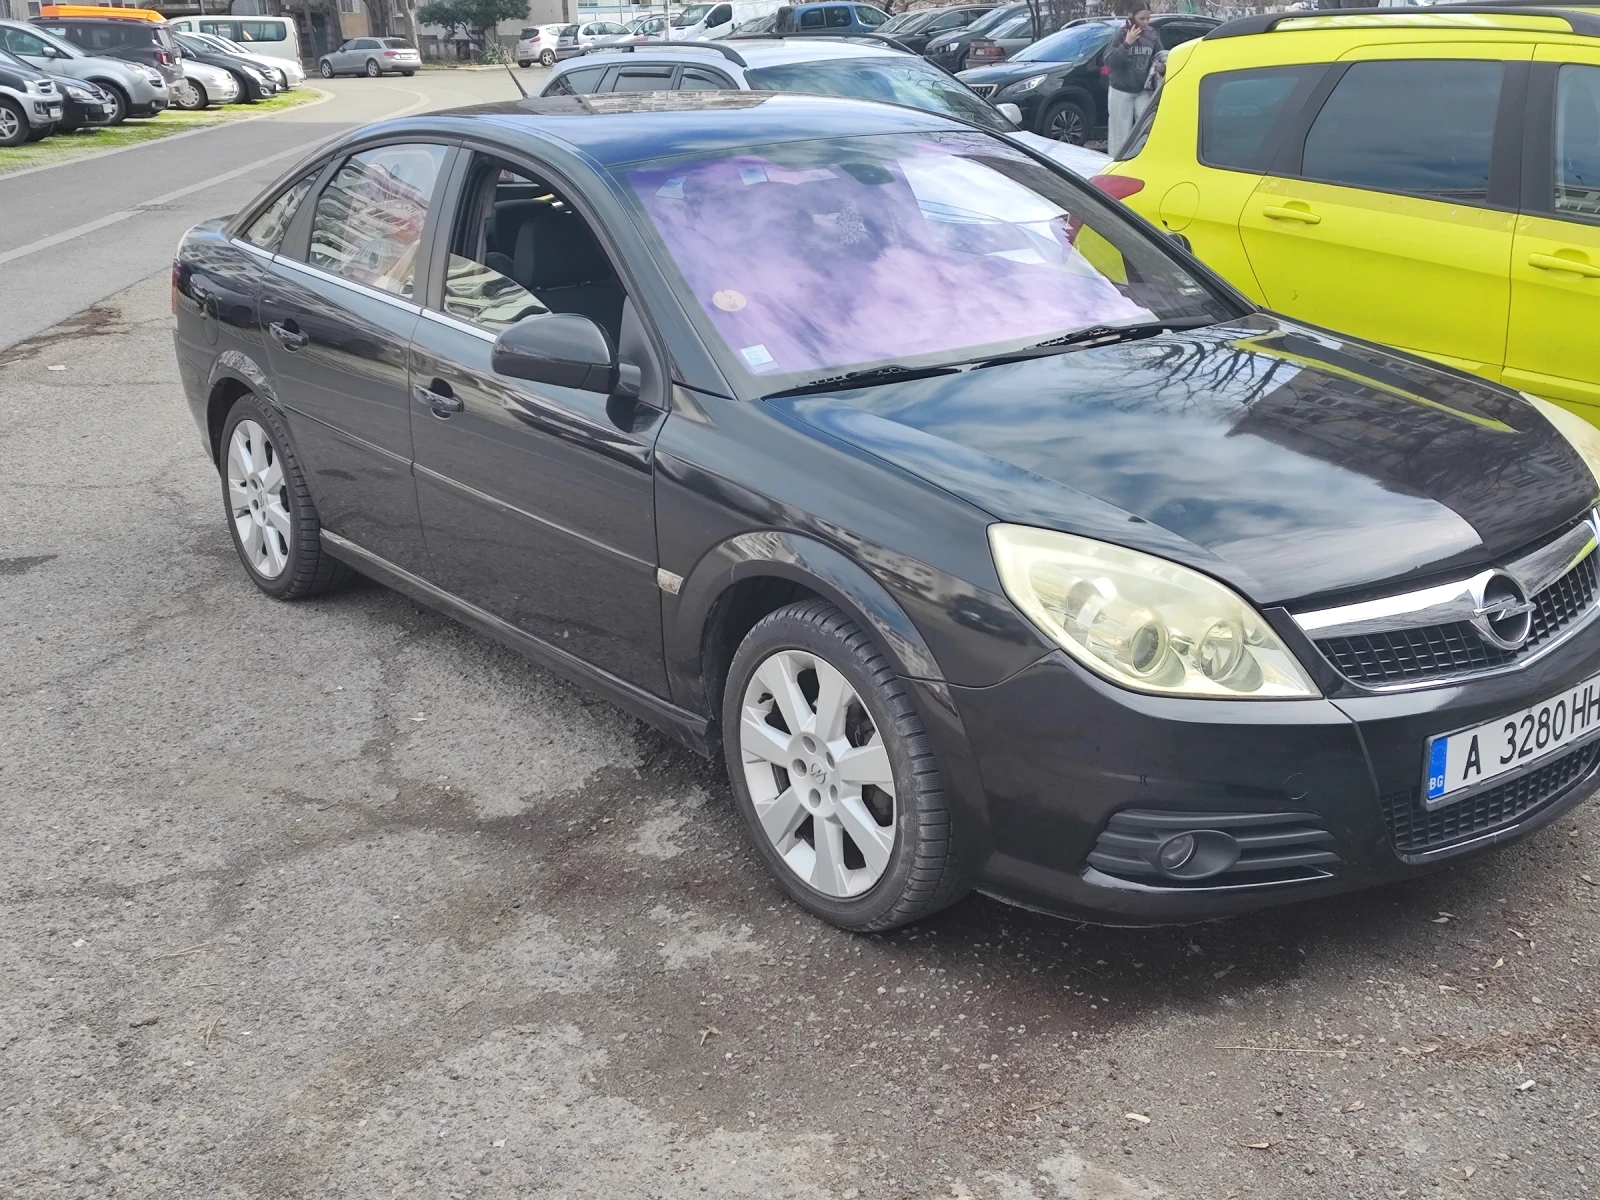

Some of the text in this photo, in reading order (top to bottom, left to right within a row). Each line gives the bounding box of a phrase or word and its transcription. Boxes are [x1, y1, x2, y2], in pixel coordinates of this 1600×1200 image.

[1463, 734, 1481, 780] A
[1500, 699, 1566, 764] 3280
[1429, 775, 1444, 790] BG
